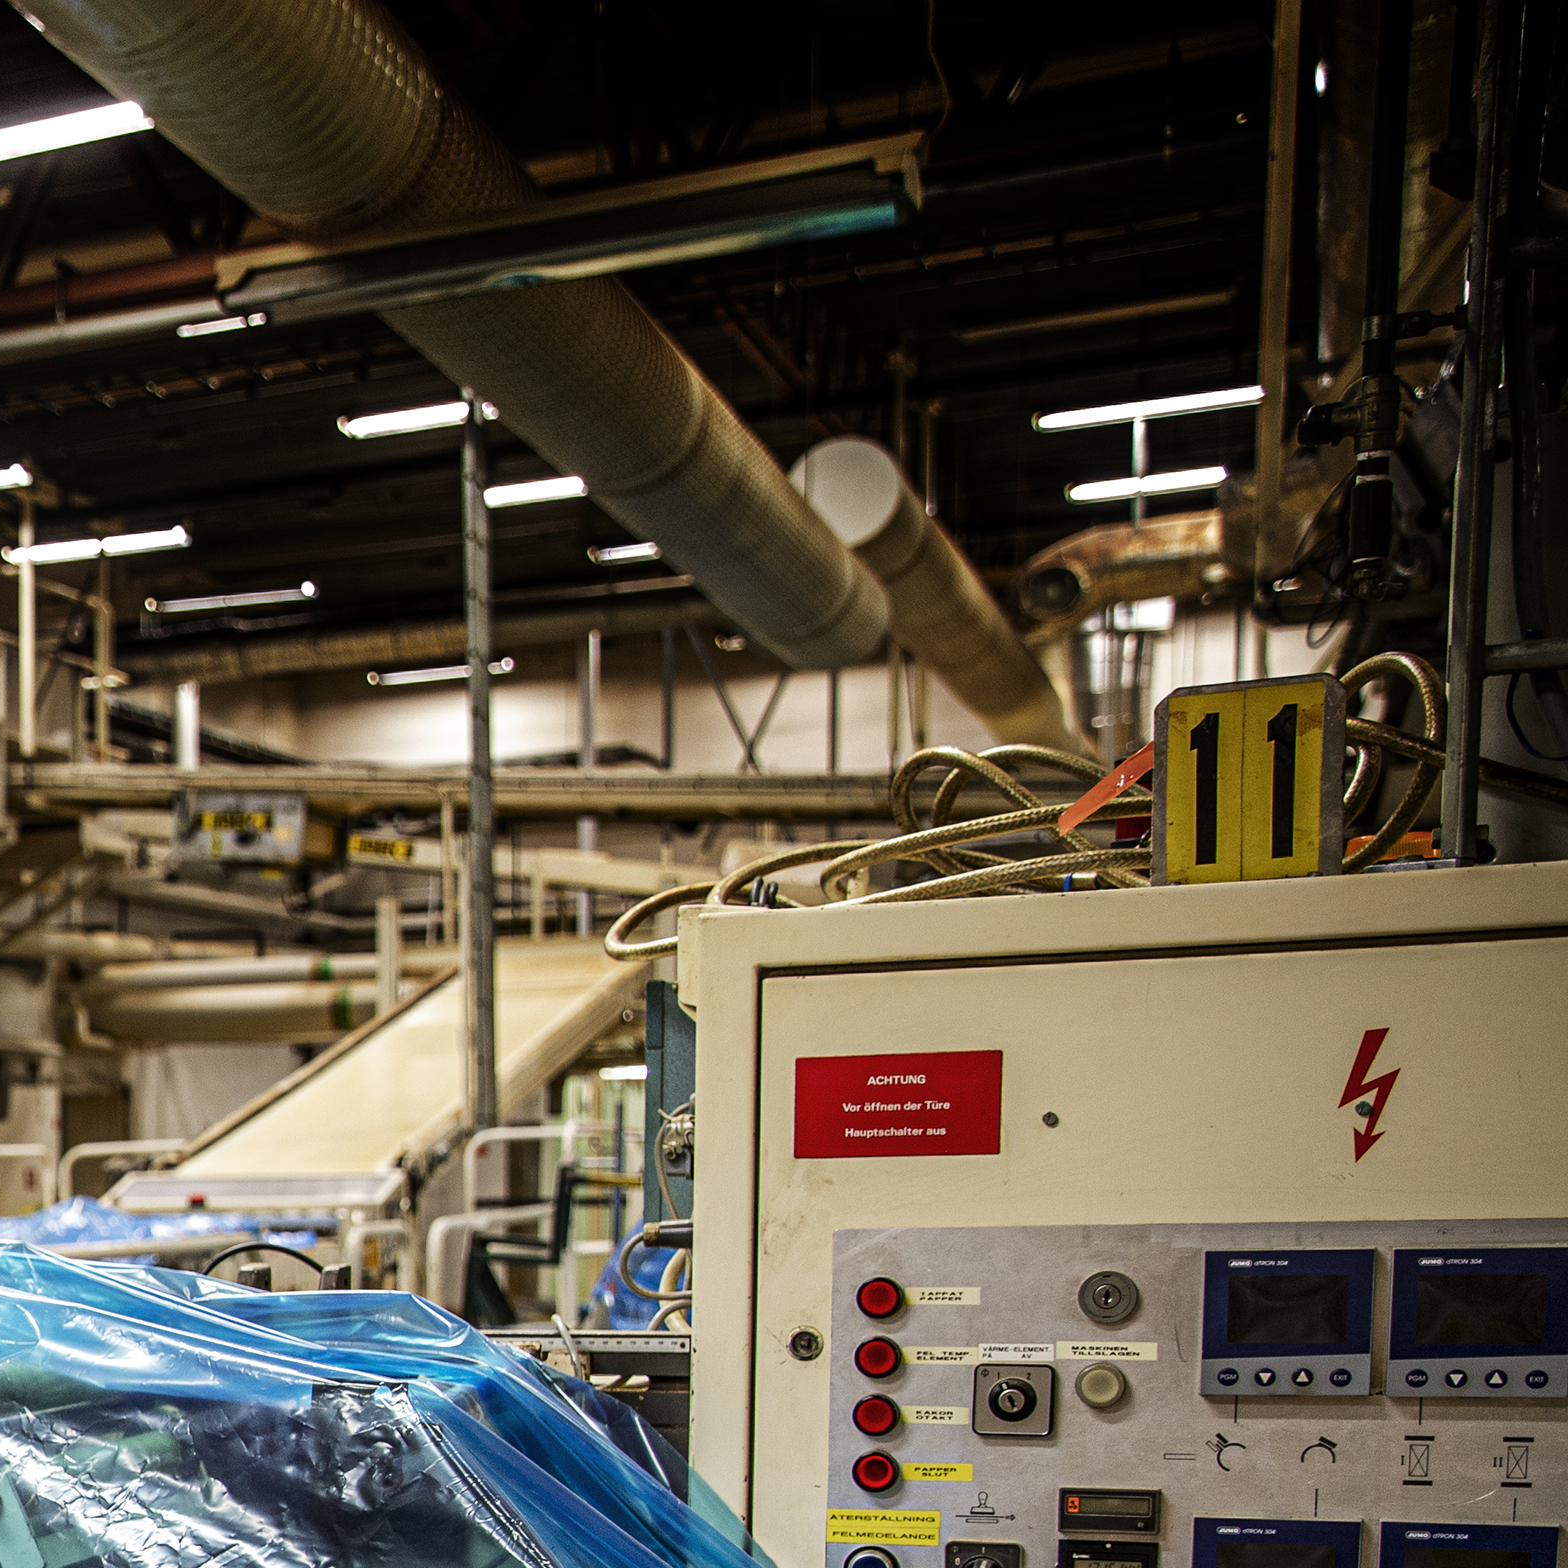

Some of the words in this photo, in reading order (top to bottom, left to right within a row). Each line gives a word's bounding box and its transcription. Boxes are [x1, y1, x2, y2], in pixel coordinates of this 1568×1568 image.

[1189, 703, 1298, 866] 11
[867, 1074, 926, 1086] ACHTUNG
[842, 1102, 861, 1113] Vor
[864, 1101, 901, 1112] öffnen
[903, 1101, 922, 1111] der
[924, 1099, 950, 1110] Türe
[844, 1127, 924, 1139] Hauptschalter
[926, 1127, 947, 1136] aus
[1026, 1372, 1032, 1380] 2
[1219, 1373, 1237, 1381] PGM
[1529, 1375, 1544, 1383] EXIT
[832, 1531, 936, 1541] FELMEDELANDE
